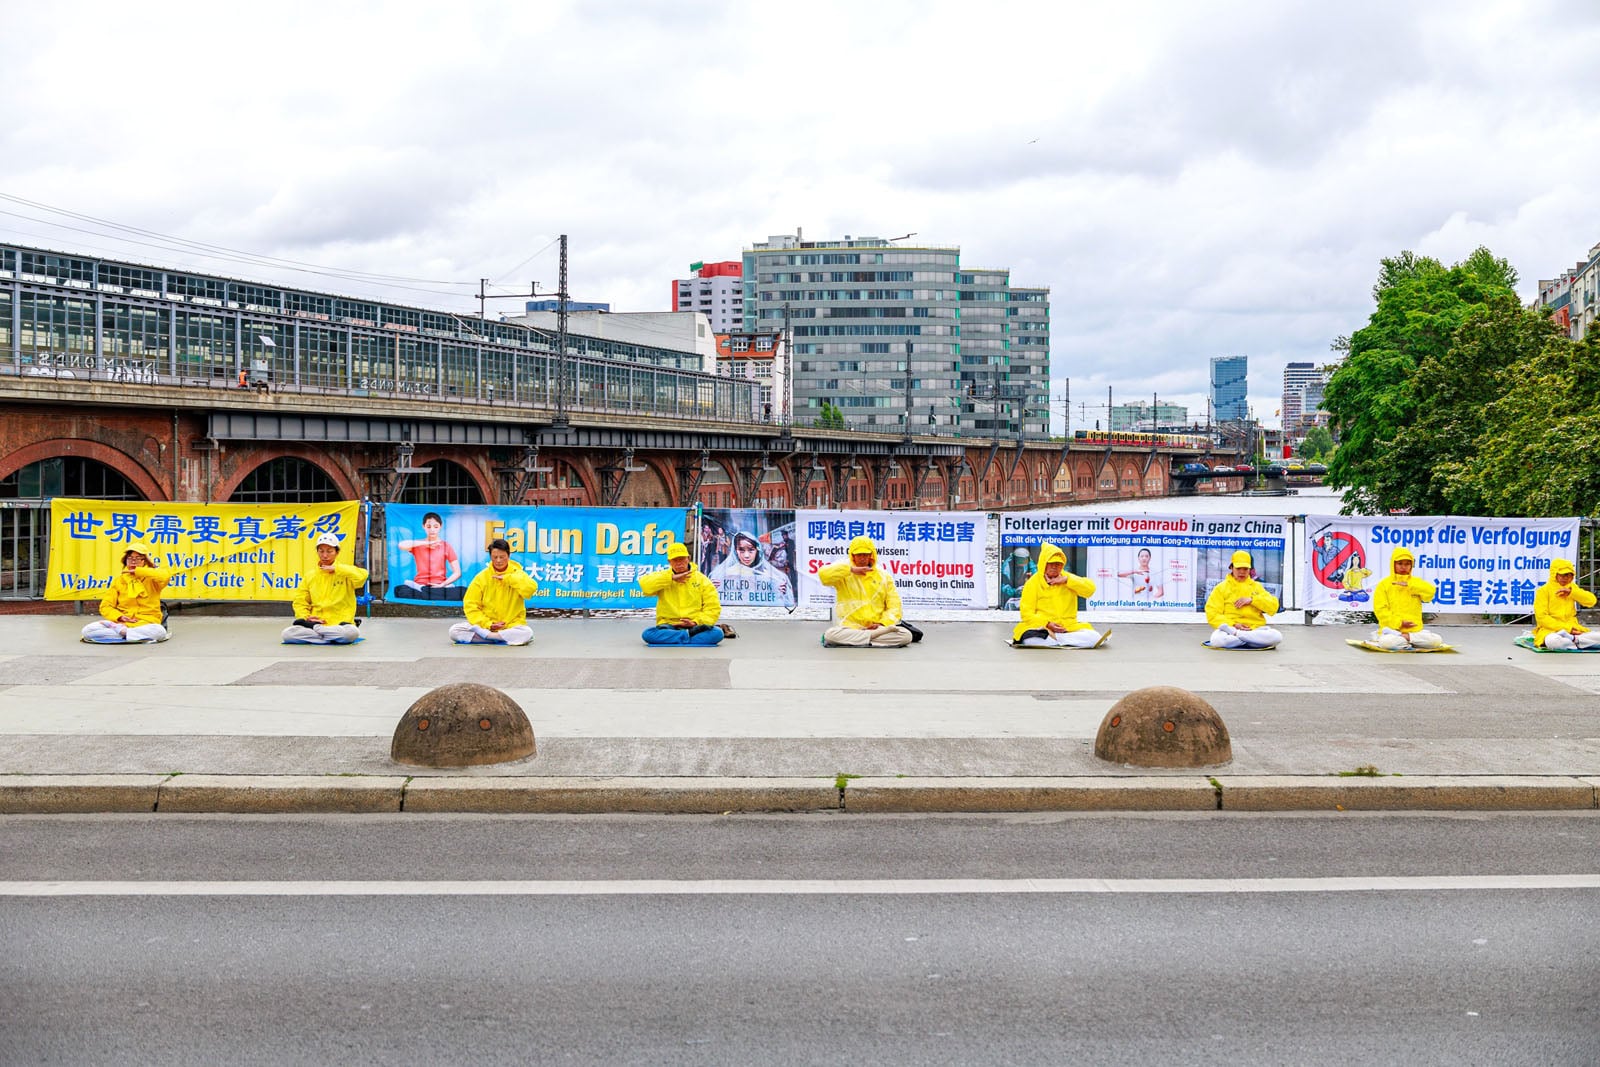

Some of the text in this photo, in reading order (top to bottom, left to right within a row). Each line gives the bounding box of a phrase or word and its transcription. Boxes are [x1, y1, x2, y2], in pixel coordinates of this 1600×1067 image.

[63, 511, 347, 545] 世界需要真善忍
[897, 521, 975, 542] 結束迫害
[1005, 517, 1282, 535] Folterlager mit Organraub in ganz China
[484, 520, 675, 556] Falun Dafa
[1005, 536, 1024, 544] Stellt
[1025, 536, 1036, 544] die
[1037, 536, 1076, 545] Verbrecher
[1078, 536, 1090, 545] der
[1091, 536, 1131, 545] Verfolgung
[1142, 537, 1161, 545] Falun
[1254, 539, 1281, 547] Gericht!
[1371, 525, 1572, 549] Stoppt die Verfolgung
[808, 546, 844, 555] Erweckt
[876, 546, 909, 556] wissen:
[166, 553, 206, 568] Welt
[891, 560, 974, 578] Verfolgung
[1418, 554, 1455, 569] Falun
[1459, 555, 1495, 572] Gong
[1498, 556, 1511, 570] in
[1514, 555, 1551, 570] China
[203, 571, 245, 588] Güte
[895, 579, 975, 591] alun Gong in China
[555, 588, 624, 600] Barmherzigkeit
[718, 591, 776, 602] THEIR BELIEF
[1421, 578, 1547, 606] 迫害法輪
[1089, 600, 1105, 608] Opfer
[1119, 600, 1135, 608] Falun
